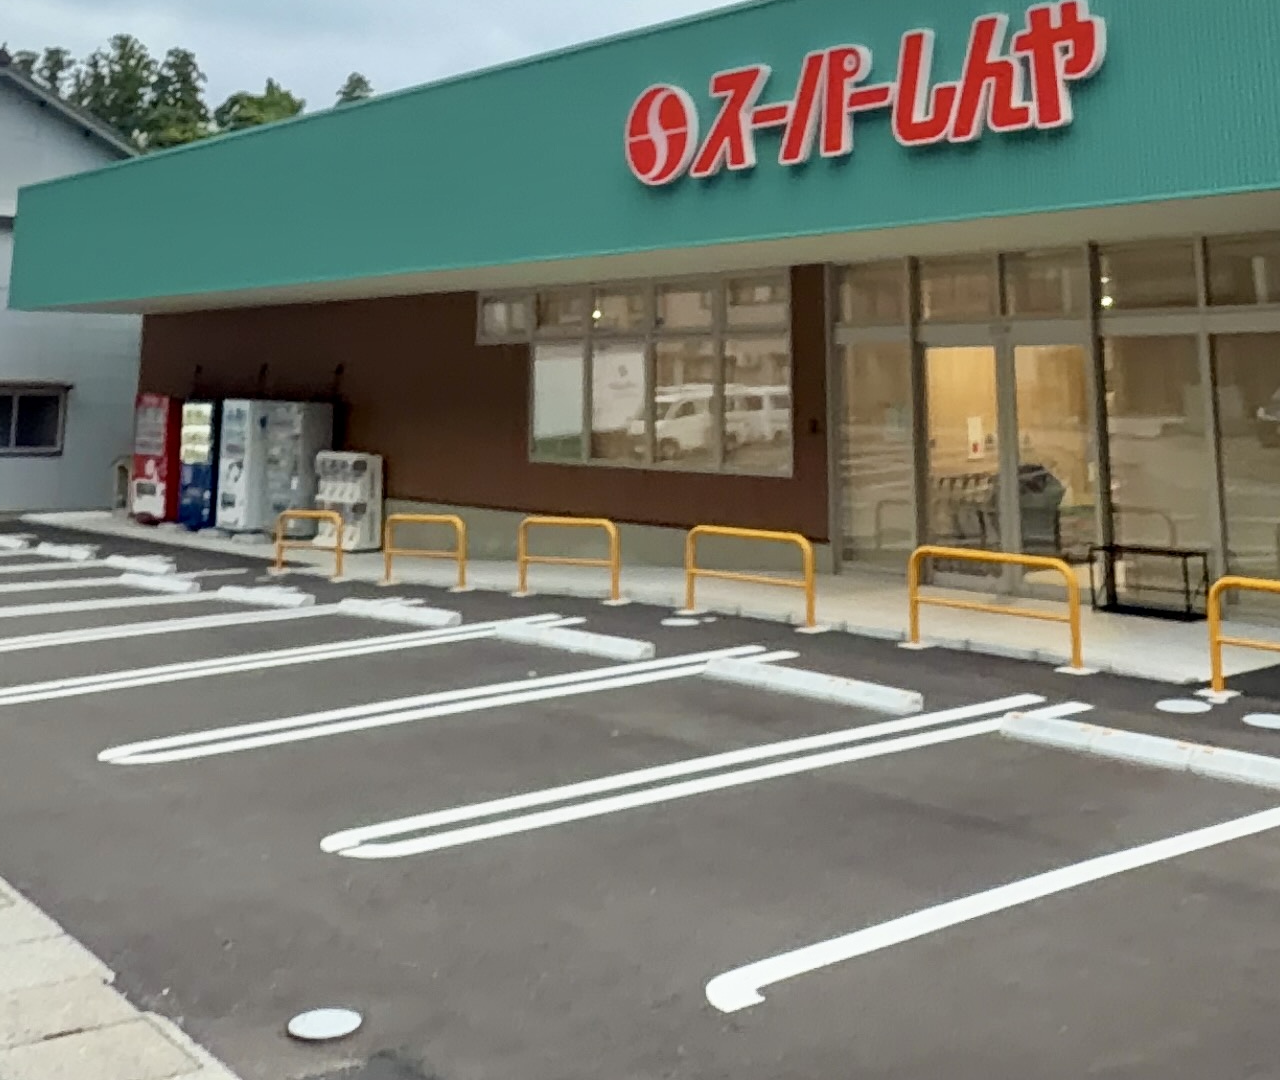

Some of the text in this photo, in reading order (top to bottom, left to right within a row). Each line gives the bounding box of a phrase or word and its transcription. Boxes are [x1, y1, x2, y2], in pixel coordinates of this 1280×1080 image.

[690, 0, 1099, 176] スーパーしんや
